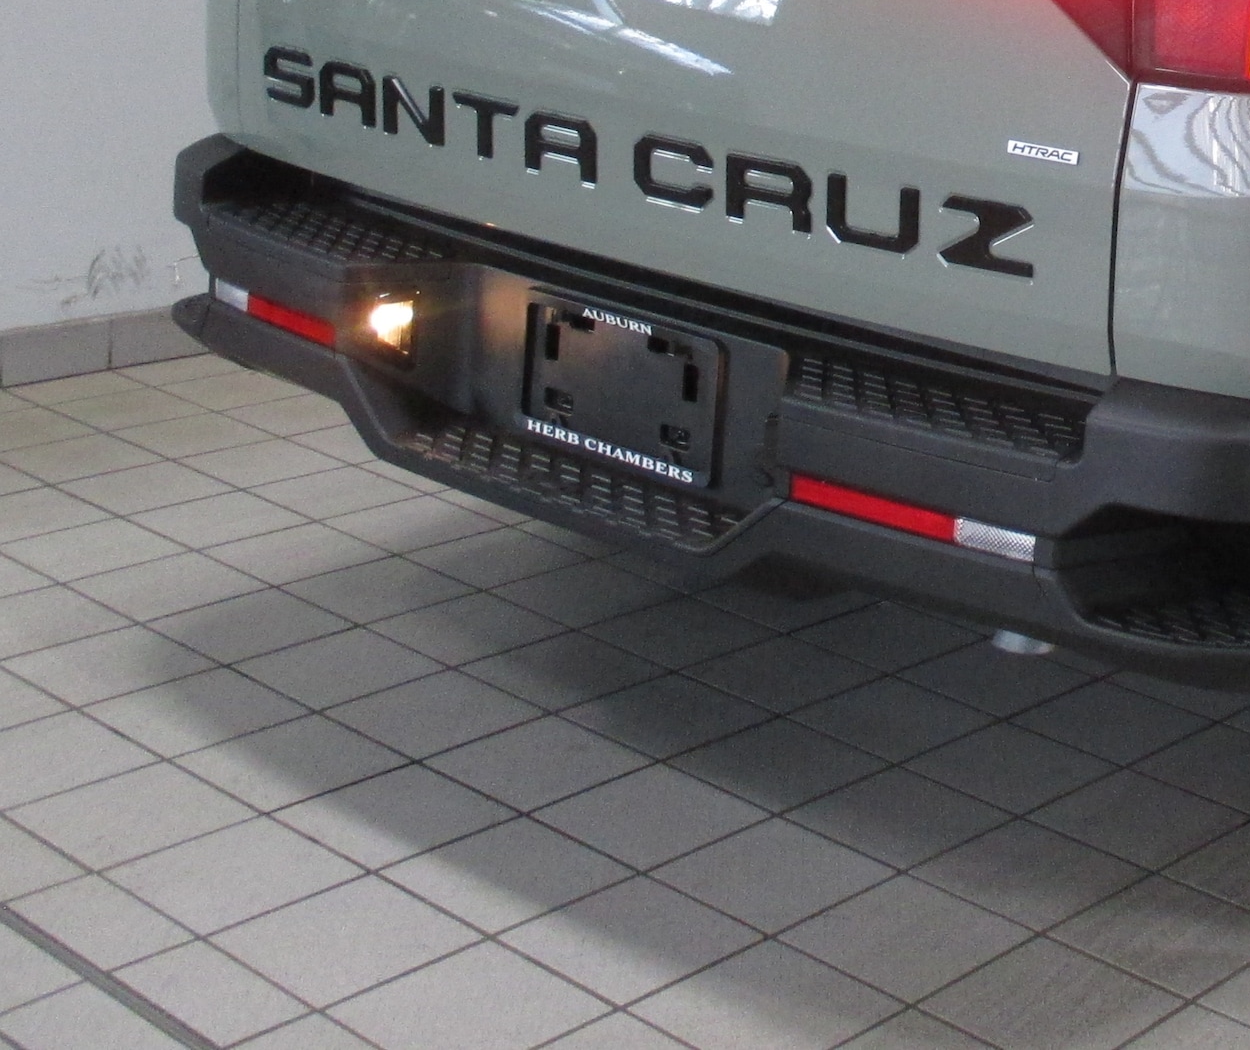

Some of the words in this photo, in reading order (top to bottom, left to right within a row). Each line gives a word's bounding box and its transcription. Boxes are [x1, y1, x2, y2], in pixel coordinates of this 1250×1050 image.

[264, 47, 598, 188] SANTA
[633, 132, 1034, 278] CRUZ
[1012, 143, 1073, 162] HTRAC
[582, 308, 652, 336] AUBURN
[527, 419, 580, 444] HERB
[585, 437, 693, 483] CHAMBERS
